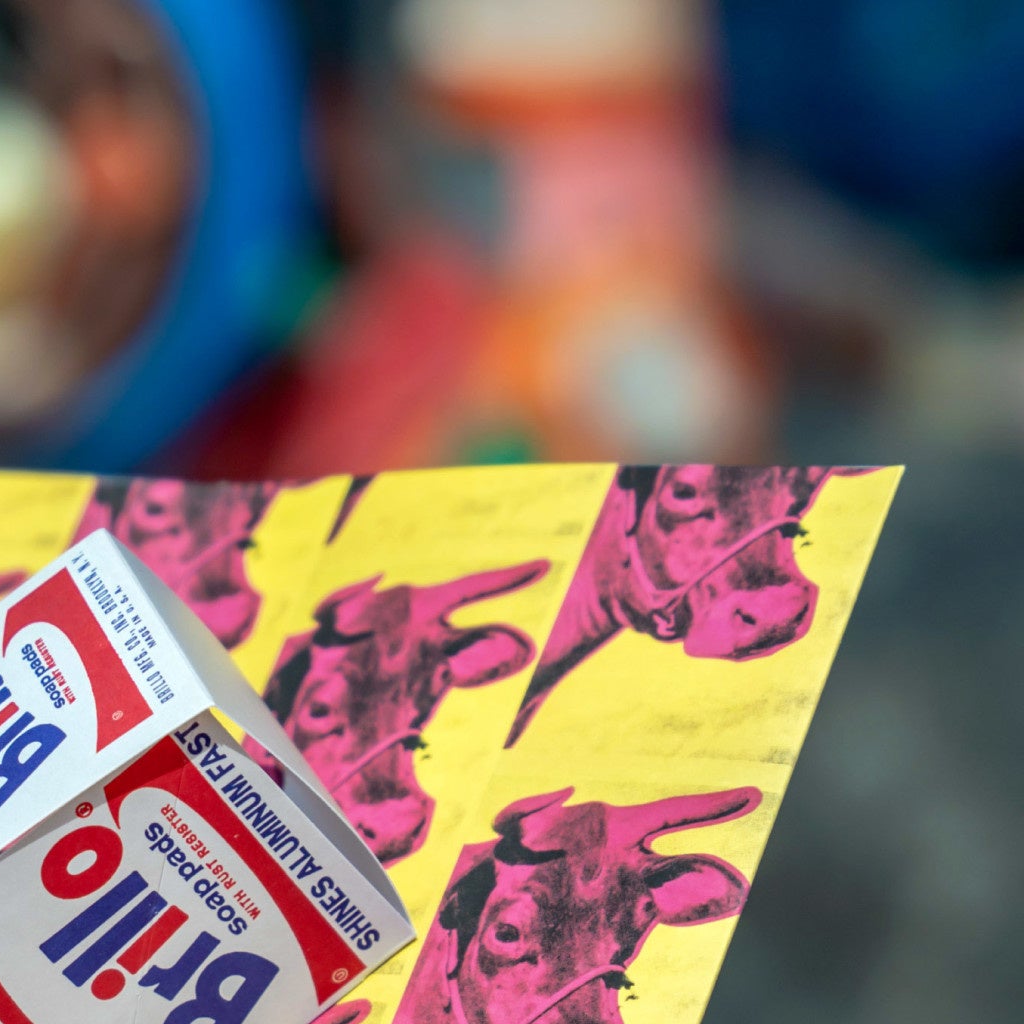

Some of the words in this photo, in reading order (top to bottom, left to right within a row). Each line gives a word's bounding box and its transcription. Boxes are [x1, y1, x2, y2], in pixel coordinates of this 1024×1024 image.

[131, 615, 142, 625] IN
[21, 643, 50, 677] pads
[40, 674, 65, 709] soap
[174, 722, 235, 782] FAST
[221, 774, 322, 879] ALUMINUM
[144, 822, 205, 882] pads
[206, 859, 236, 890] RUST
[193, 878, 248, 935] soap
[233, 890, 261, 920] WITH
[310, 876, 380, 951] SHINES
